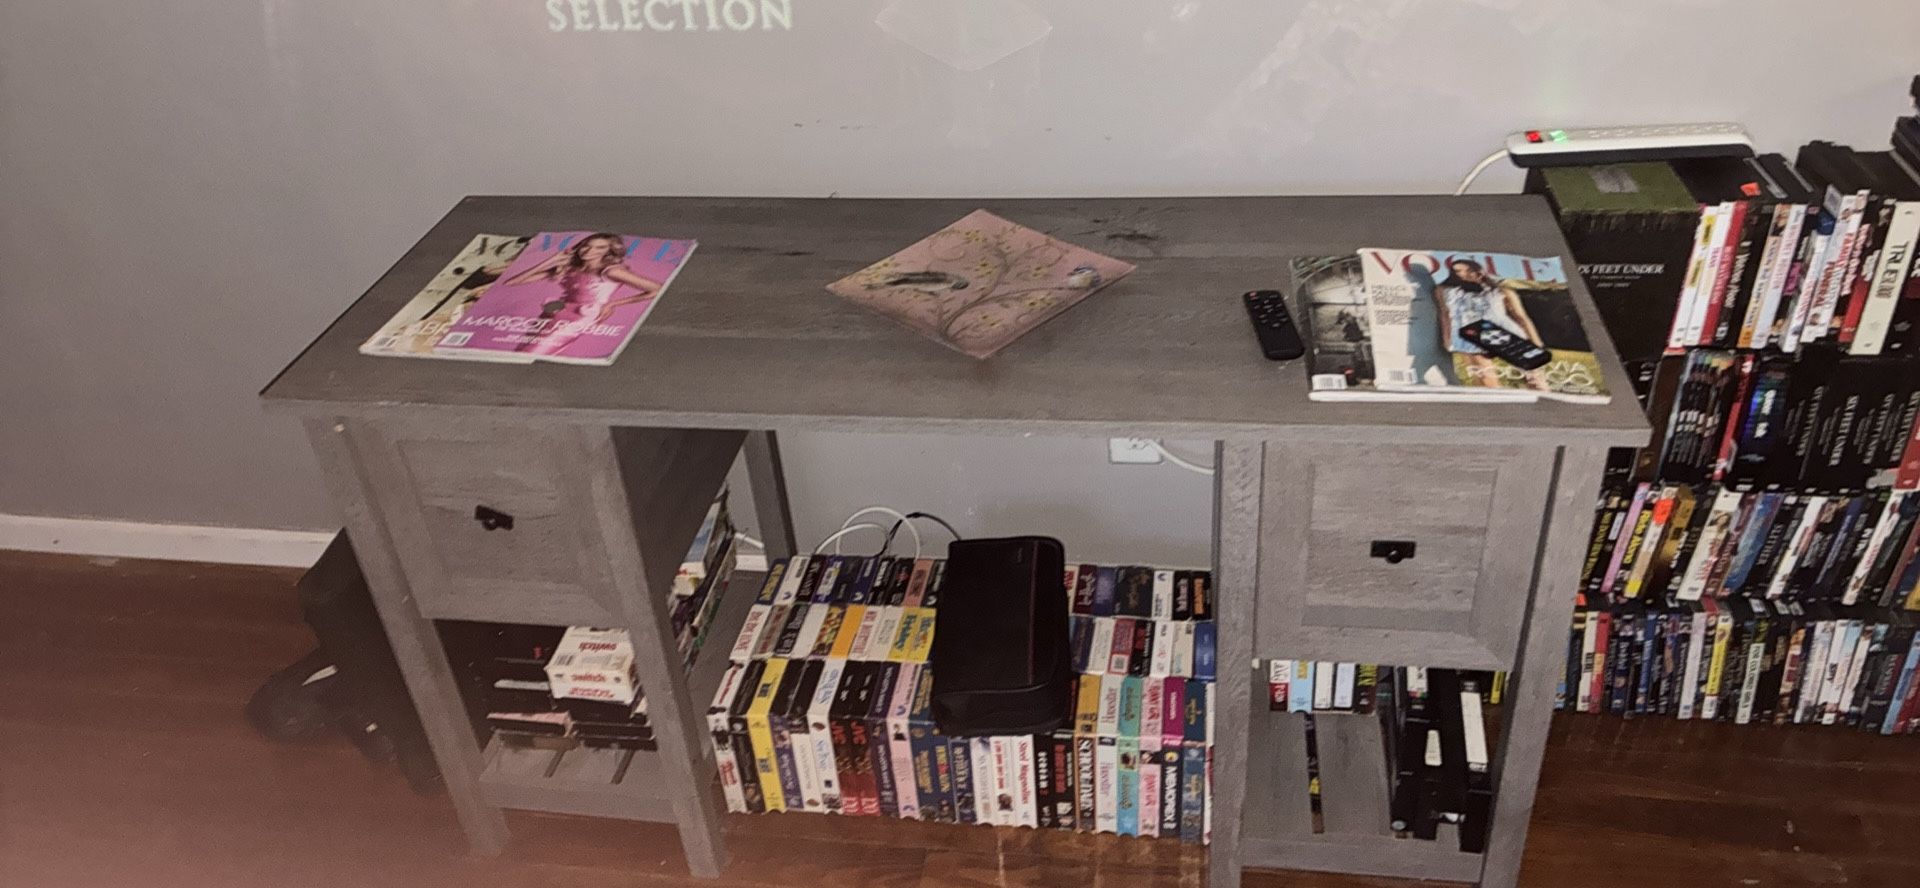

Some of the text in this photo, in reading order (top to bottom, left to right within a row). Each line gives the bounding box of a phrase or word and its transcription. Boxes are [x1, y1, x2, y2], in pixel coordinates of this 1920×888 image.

[546, 0, 793, 31] SELECTION
[1592, 264, 1621, 274] FEET
[1622, 264, 1665, 274] UNDER
[463, 315, 553, 332] MARGOT
[851, 720, 866, 745] JVC
[1163, 766, 1178, 821] MEMOREX
